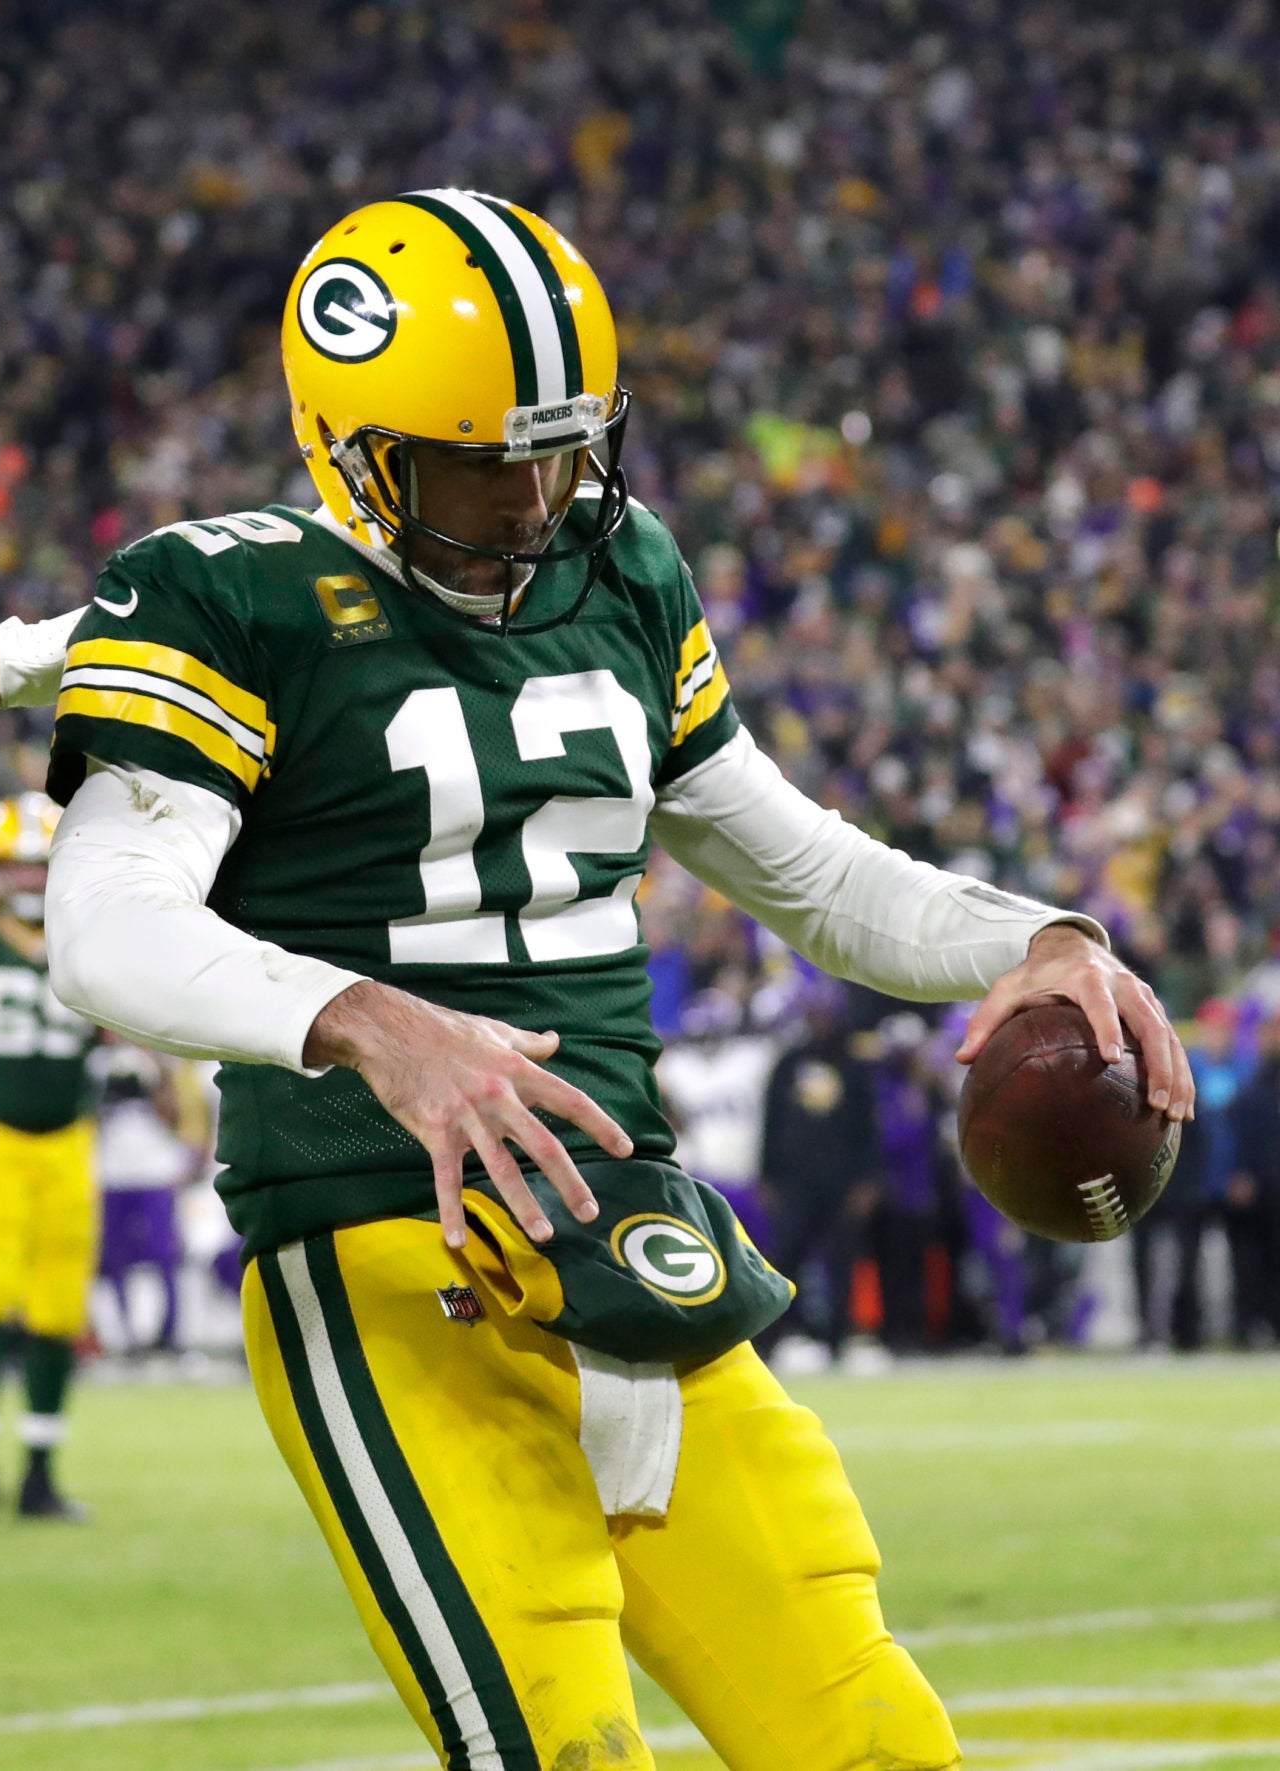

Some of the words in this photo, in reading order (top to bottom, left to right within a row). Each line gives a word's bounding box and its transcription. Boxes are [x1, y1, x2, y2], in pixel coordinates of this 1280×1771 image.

[299, 263, 391, 357] G
[532, 405, 574, 425] PACKERS
[315, 574, 381, 625] C
[384, 669, 656, 964] 12
[623, 1223, 716, 1293] G
